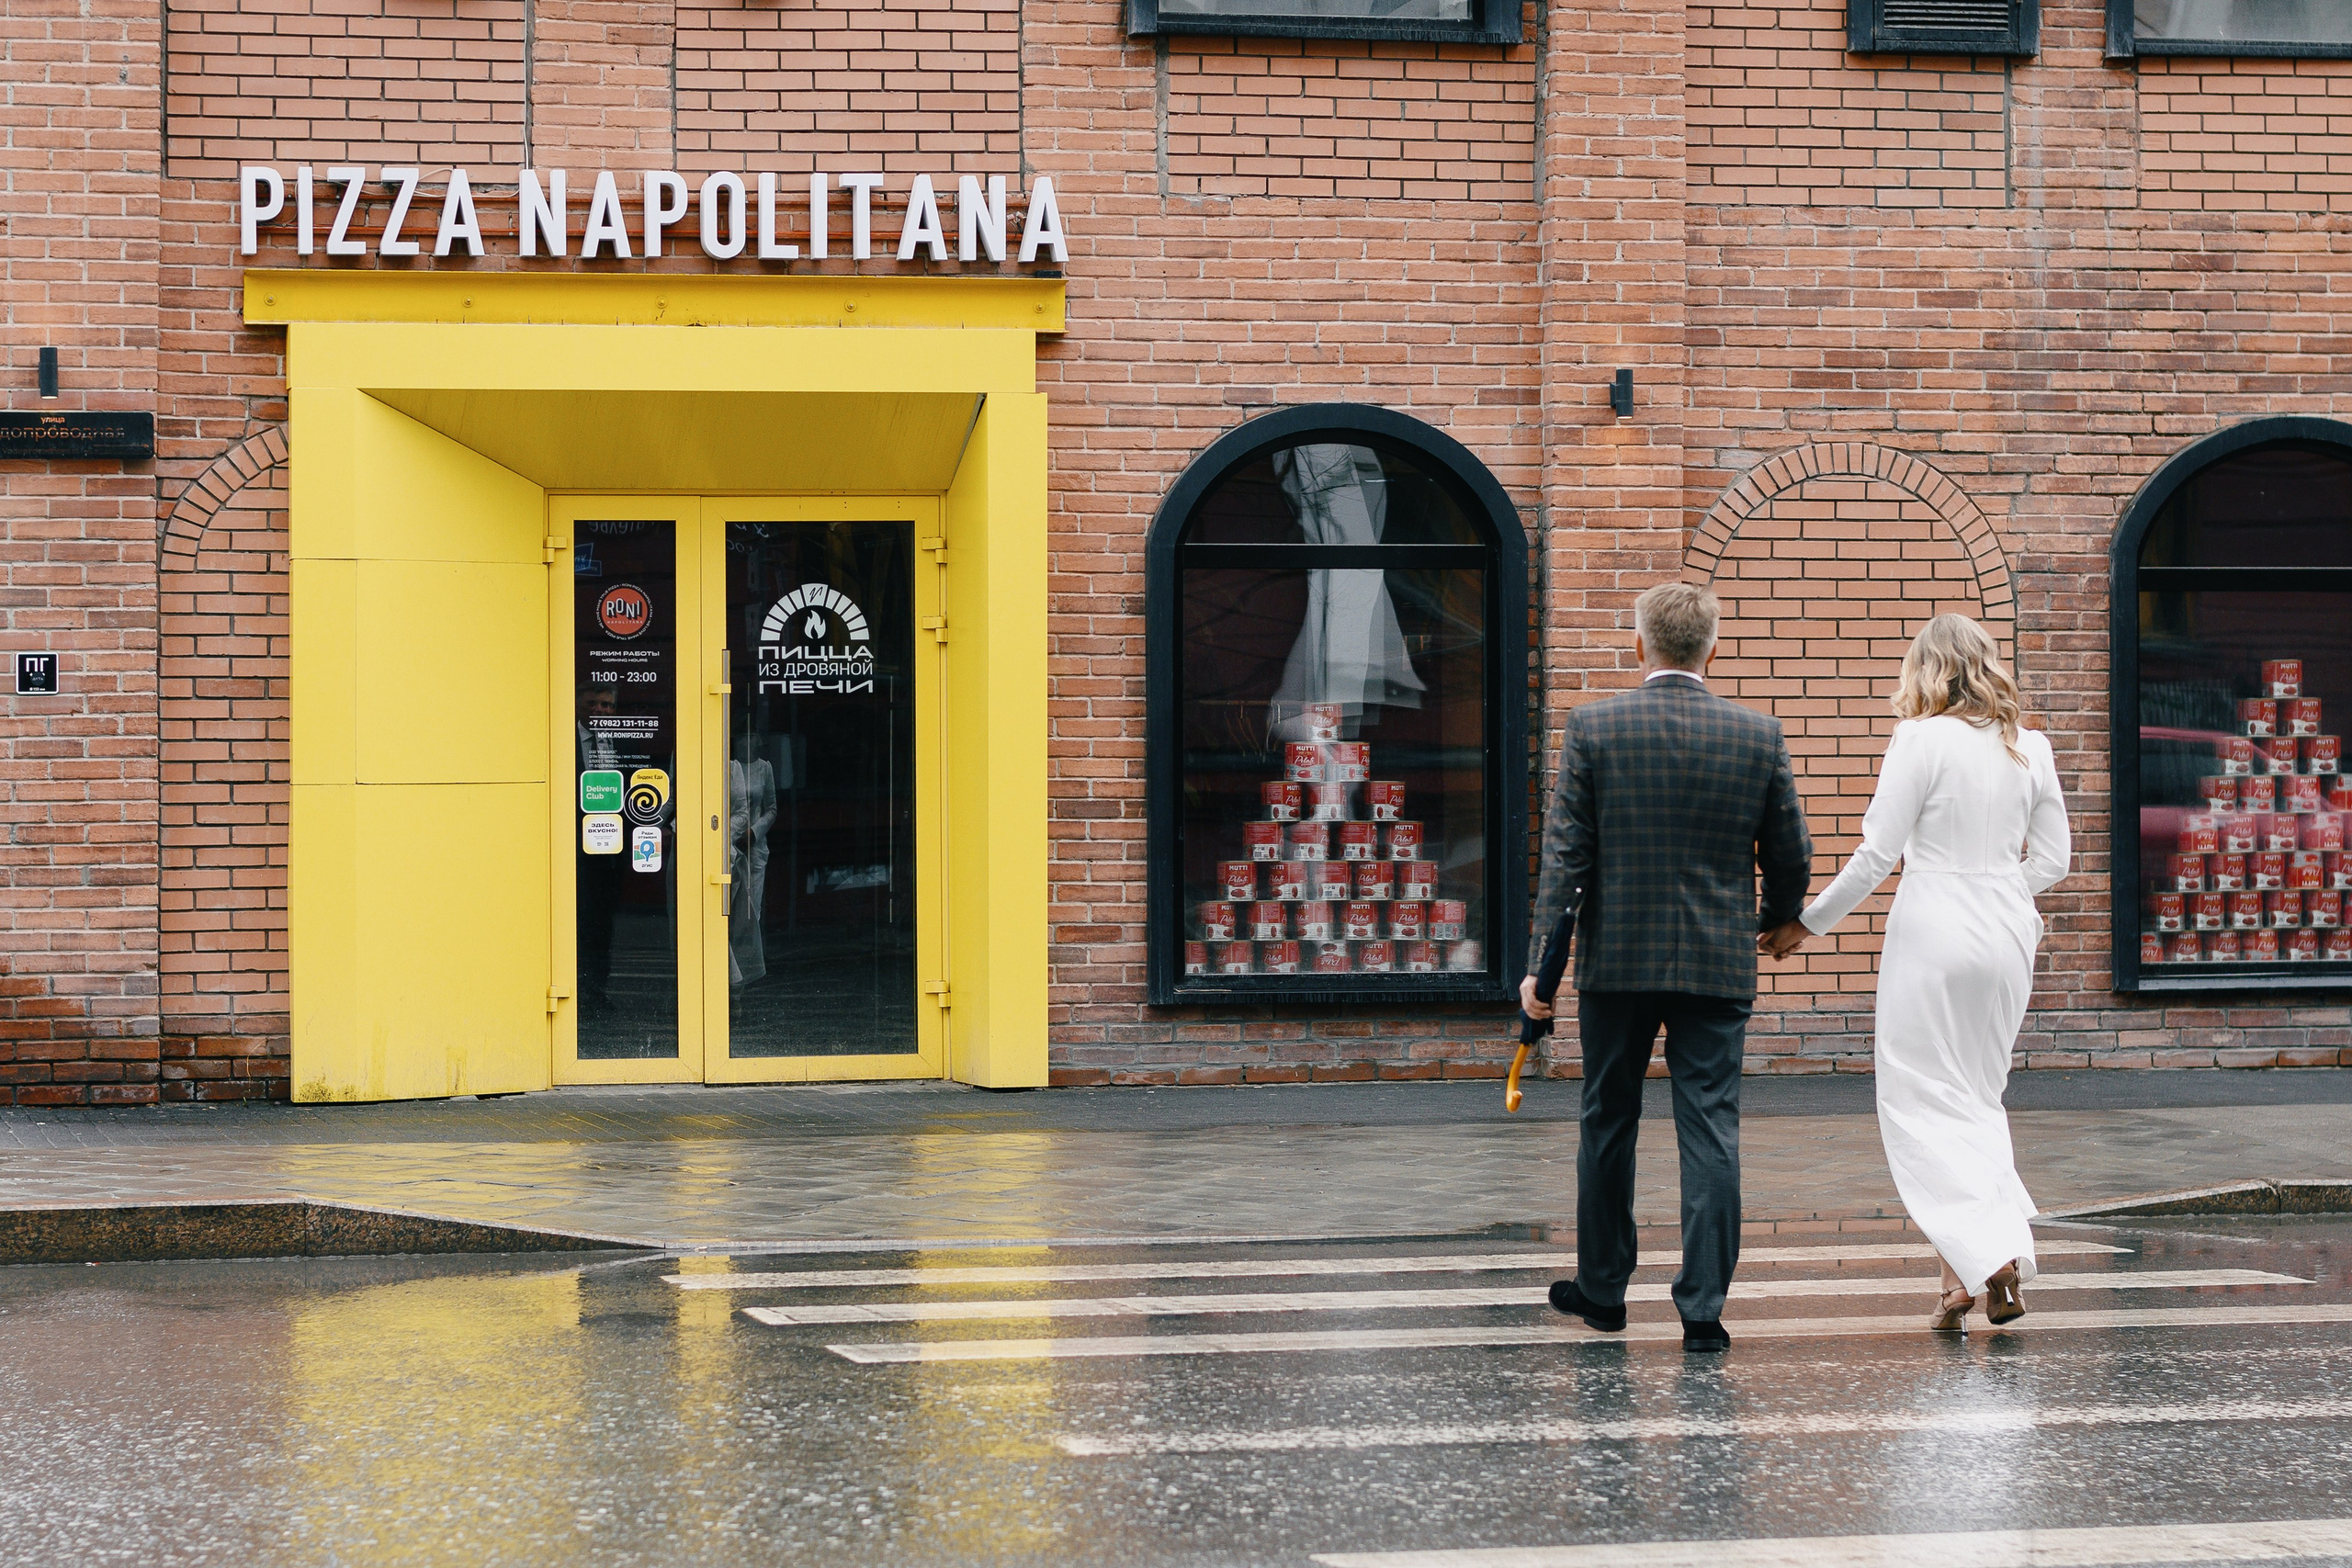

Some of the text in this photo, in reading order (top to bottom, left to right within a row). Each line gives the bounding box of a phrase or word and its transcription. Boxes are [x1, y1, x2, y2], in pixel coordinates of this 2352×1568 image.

[241, 166, 1070, 264] PIZZA NAPOLITANA
[40, 416, 65, 424] улица
[606, 598, 641, 618] RONI
[759, 645, 875, 661] ПИЦЦА
[26, 658, 49, 671] ПГ
[759, 659, 873, 678] ИЗ ДРОВЯНОЙ
[591, 671, 617, 682] 11:00
[627, 671, 657, 682] 23:00
[759, 680, 873, 694] ПЕЧИ
